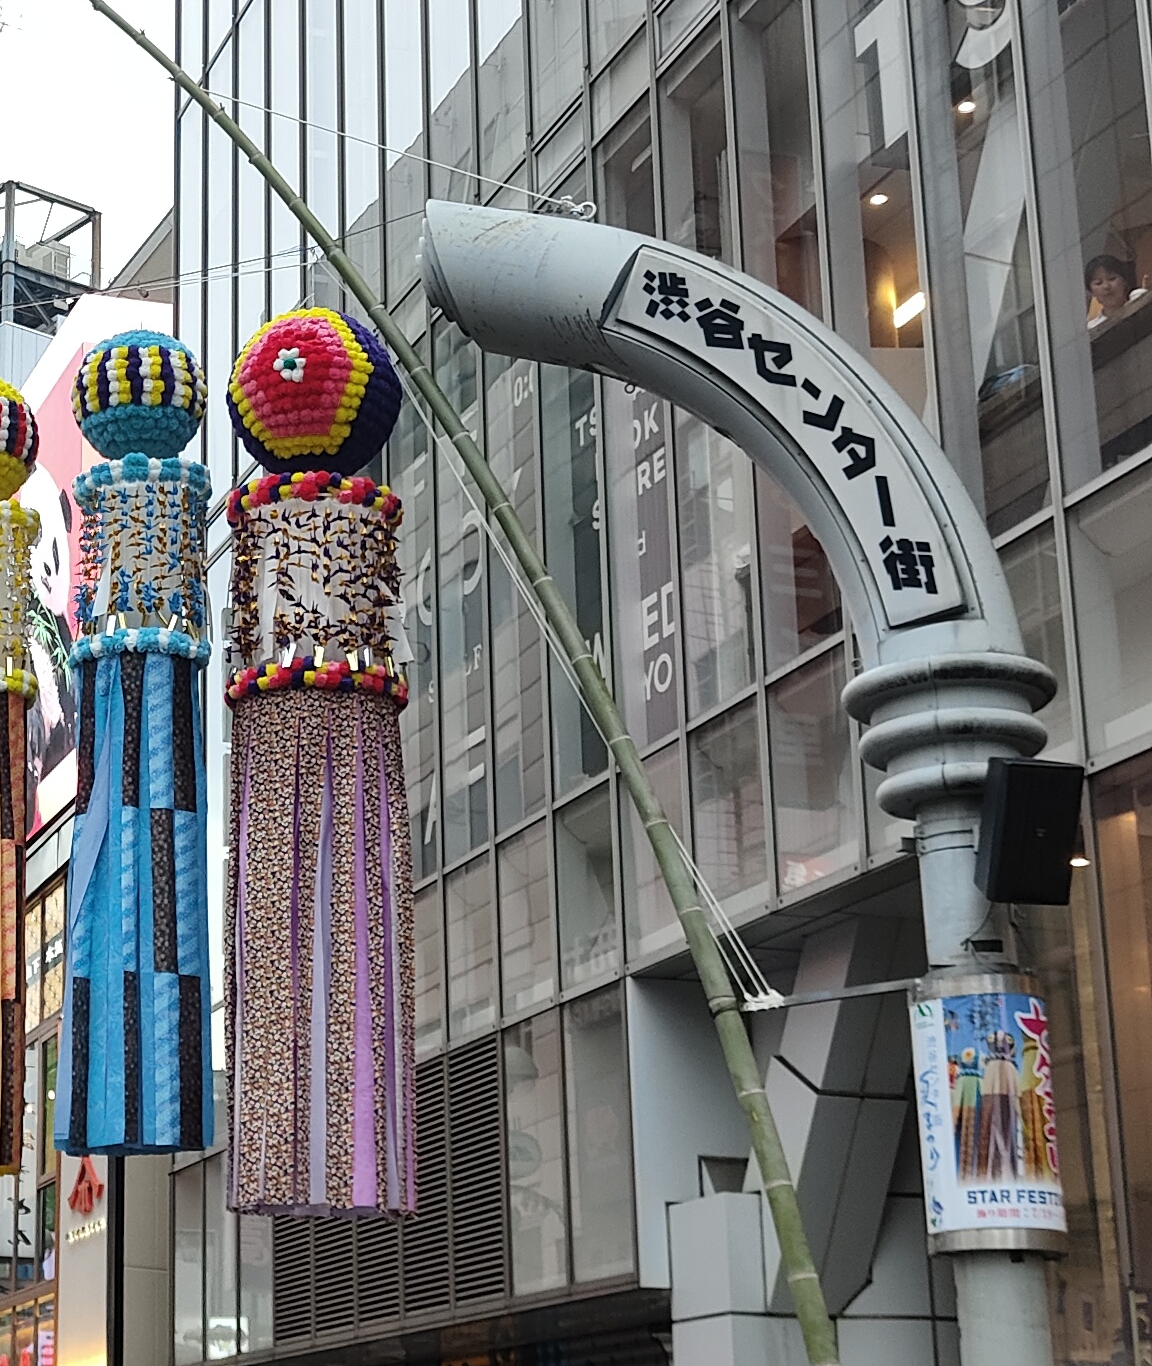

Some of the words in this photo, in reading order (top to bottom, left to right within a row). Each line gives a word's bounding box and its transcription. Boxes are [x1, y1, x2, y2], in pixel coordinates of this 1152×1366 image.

[642, 269, 939, 595] 渋谷センター街
[967, 1188, 1011, 1206] STAR
